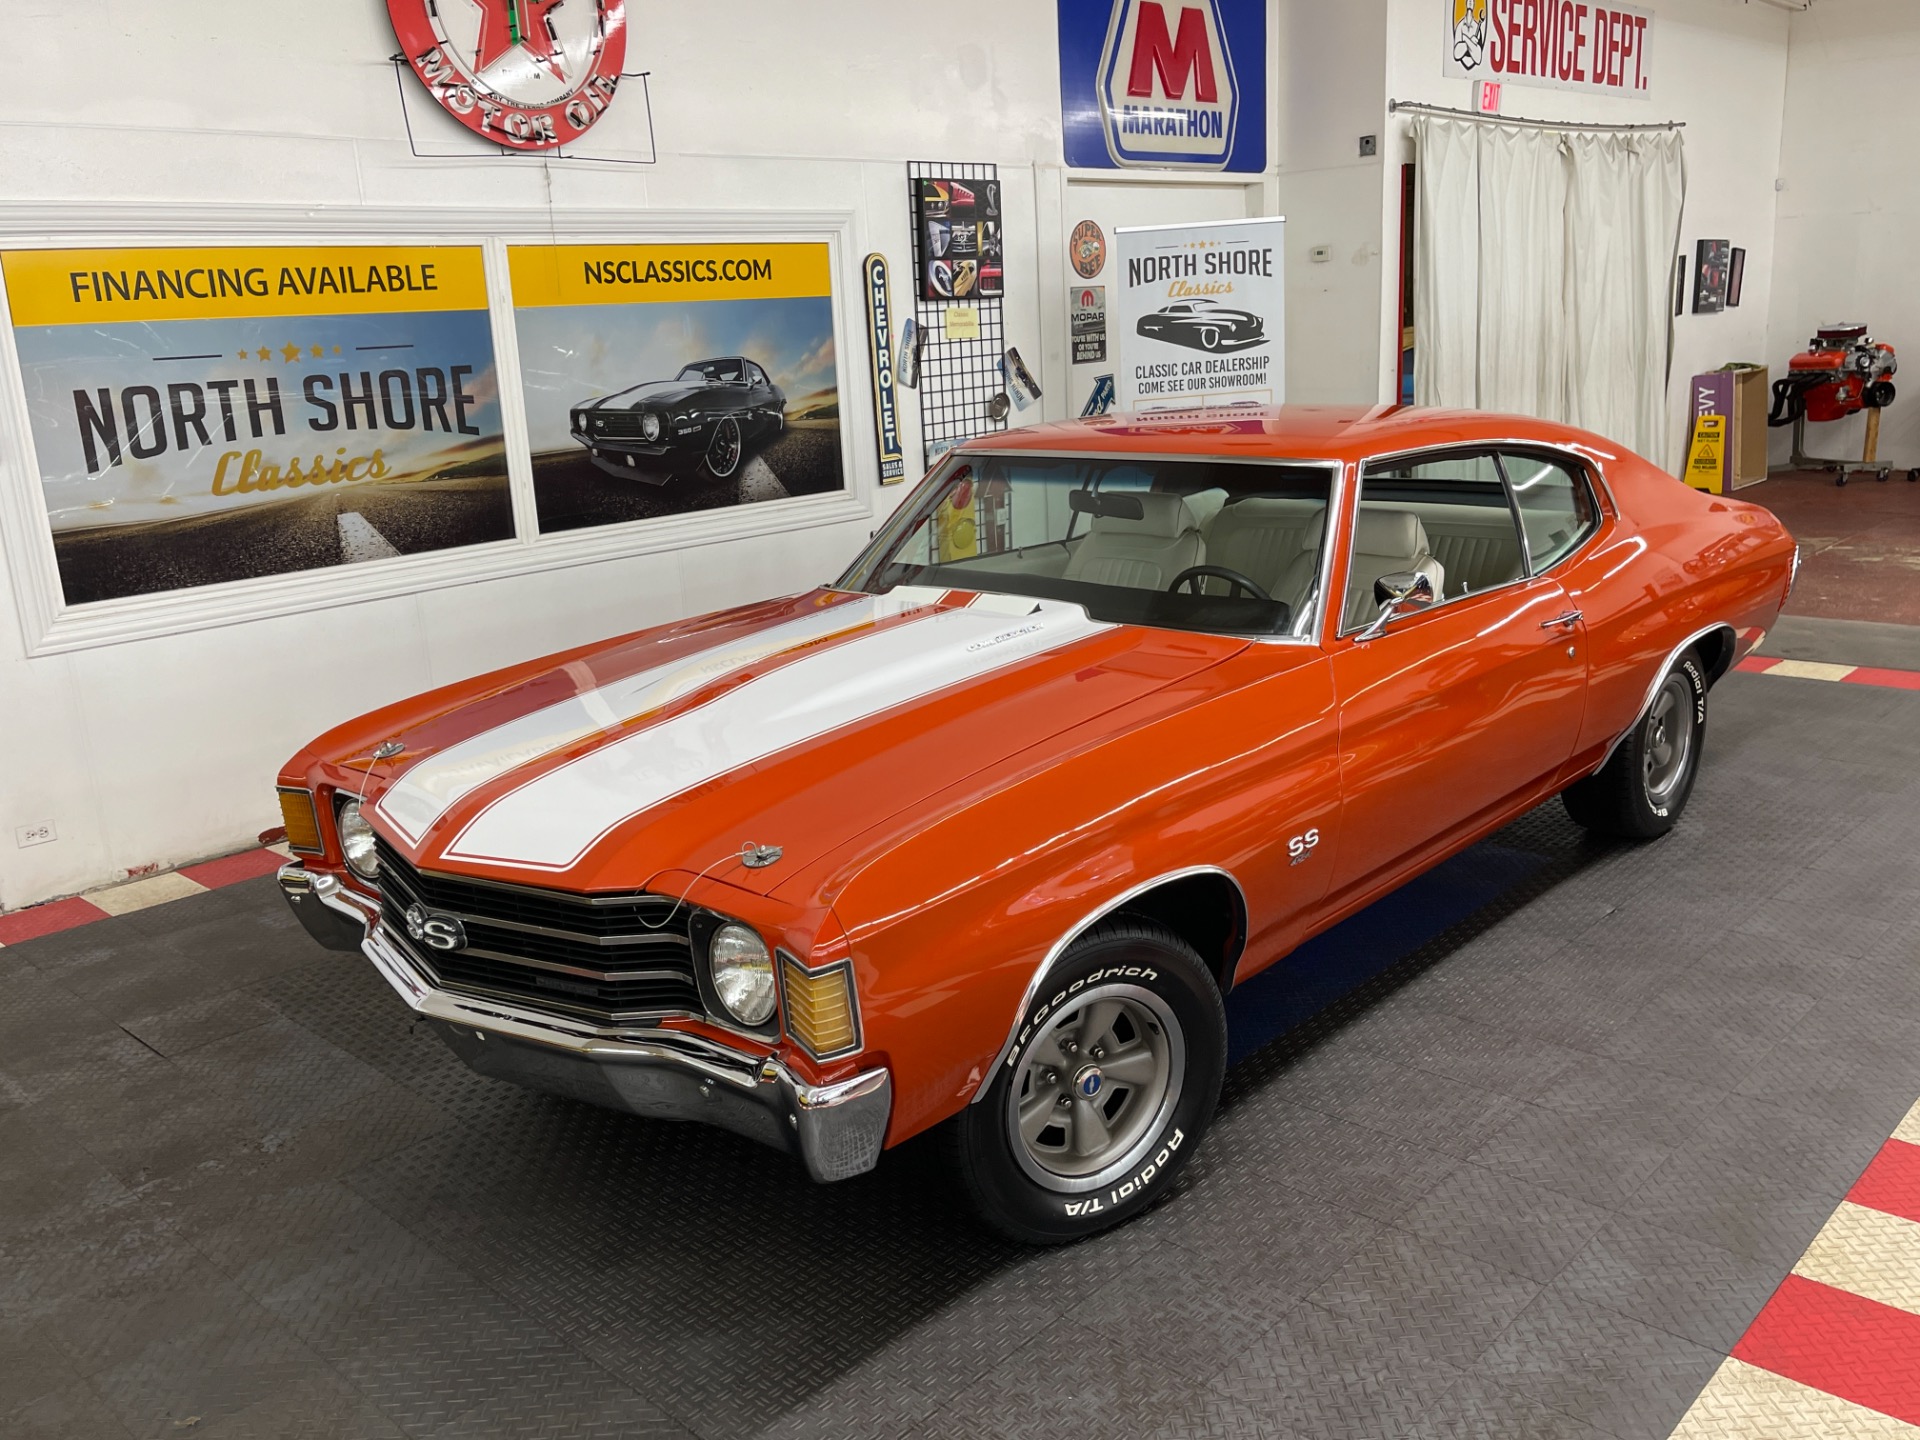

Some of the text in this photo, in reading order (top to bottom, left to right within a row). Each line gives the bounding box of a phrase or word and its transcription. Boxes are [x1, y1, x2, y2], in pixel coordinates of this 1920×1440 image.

[1127, 1, 1218, 103] M
[1490, 0, 1647, 90] SERVICE DEPT.
[415, 47, 620, 146] MOTOR OIL
[1482, 82, 1501, 111] EXIT
[1122, 105, 1222, 139] MARATHON
[1073, 223, 1102, 254] SUPER
[70, 264, 438, 303] FINANCING AVAILABLE
[584, 259, 773, 285] NSCLASSICS.COM
[1079, 253, 1101, 276] BEE
[1129, 248, 1273, 288] NORTH SHORE
[1167, 280, 1234, 298] Classics
[1071, 312, 1105, 322] MOPAR
[872, 265, 895, 450] CHEVROLET
[1135, 356, 1270, 379] CLASSIC CAR DEALERSHIP
[1138, 373, 1267, 394] COME SEE OUR SHOWROOM!
[72, 365, 481, 475] NORTH SHORE
[211, 448, 393, 497] Classics
[883, 468, 903, 477] SERVICE
[1683, 661, 1705, 724] Radial T/A
[1288, 828, 1319, 857] SS
[406, 906, 459, 950] SS
[1006, 965, 1158, 1067] BFGoodrich
[1064, 1128, 1185, 1217] Radial T/A
